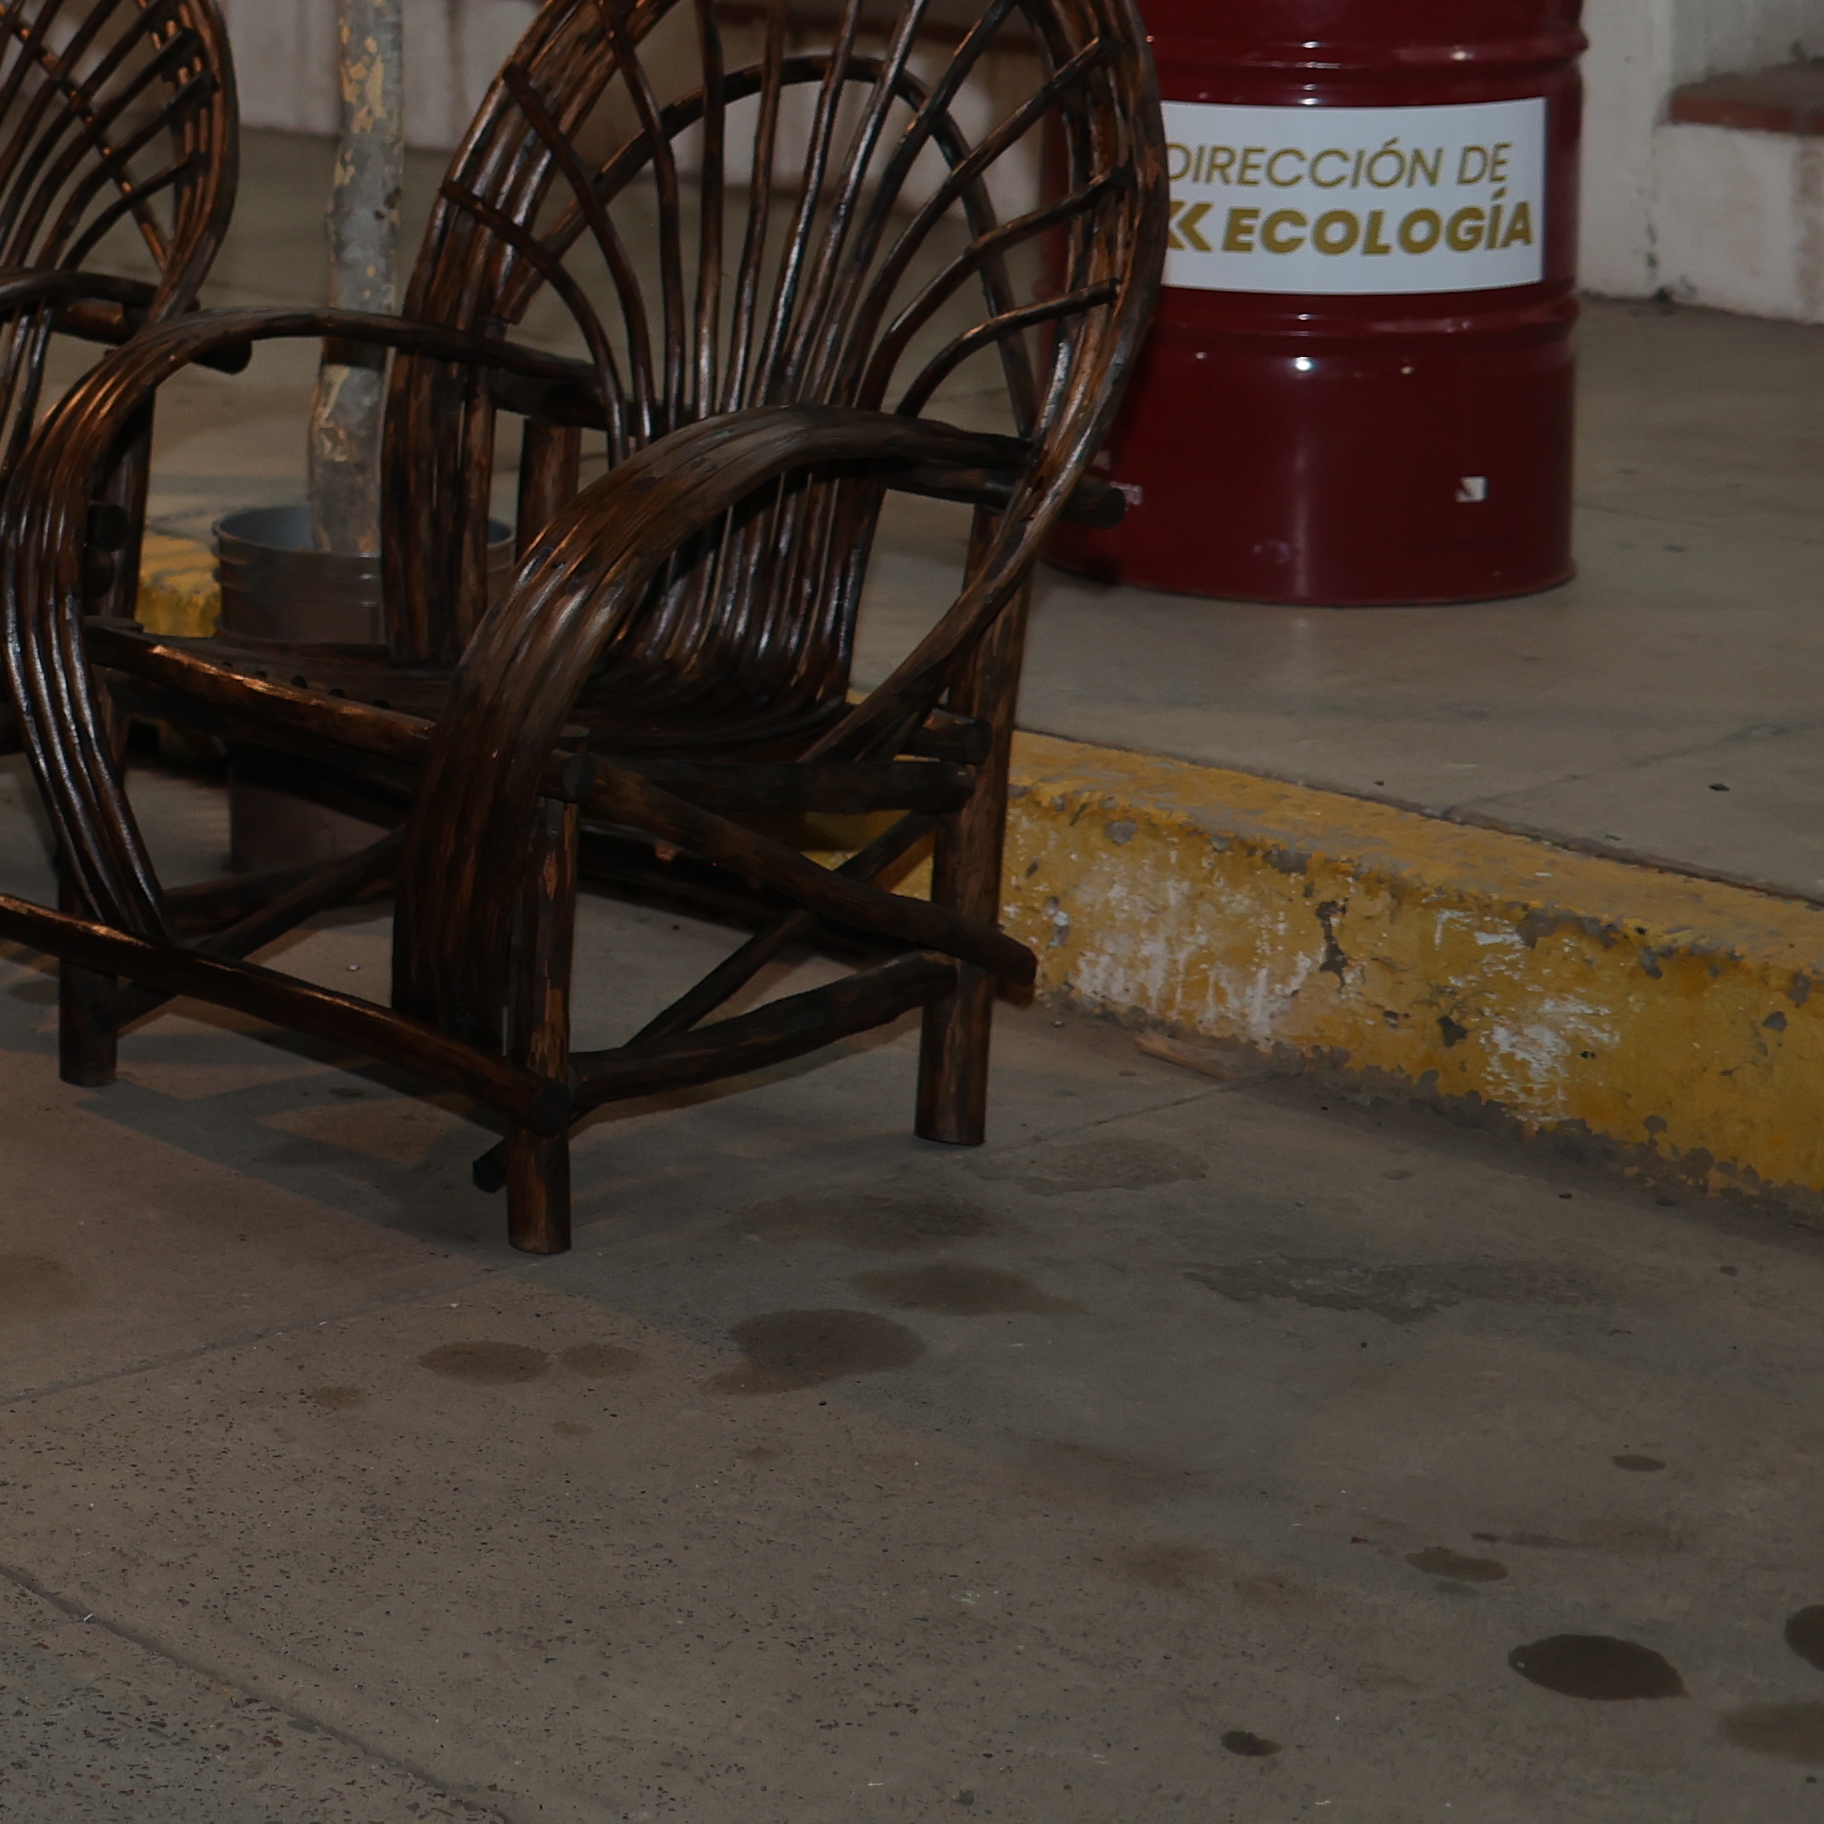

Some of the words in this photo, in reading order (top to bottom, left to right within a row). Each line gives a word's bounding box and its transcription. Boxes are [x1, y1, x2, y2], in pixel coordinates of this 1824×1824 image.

[1167, 137, 1444, 189] DIRECCIÓN
[1457, 142, 1513, 185] DE
[1221, 187, 1534, 256] ECOLOGÍA
